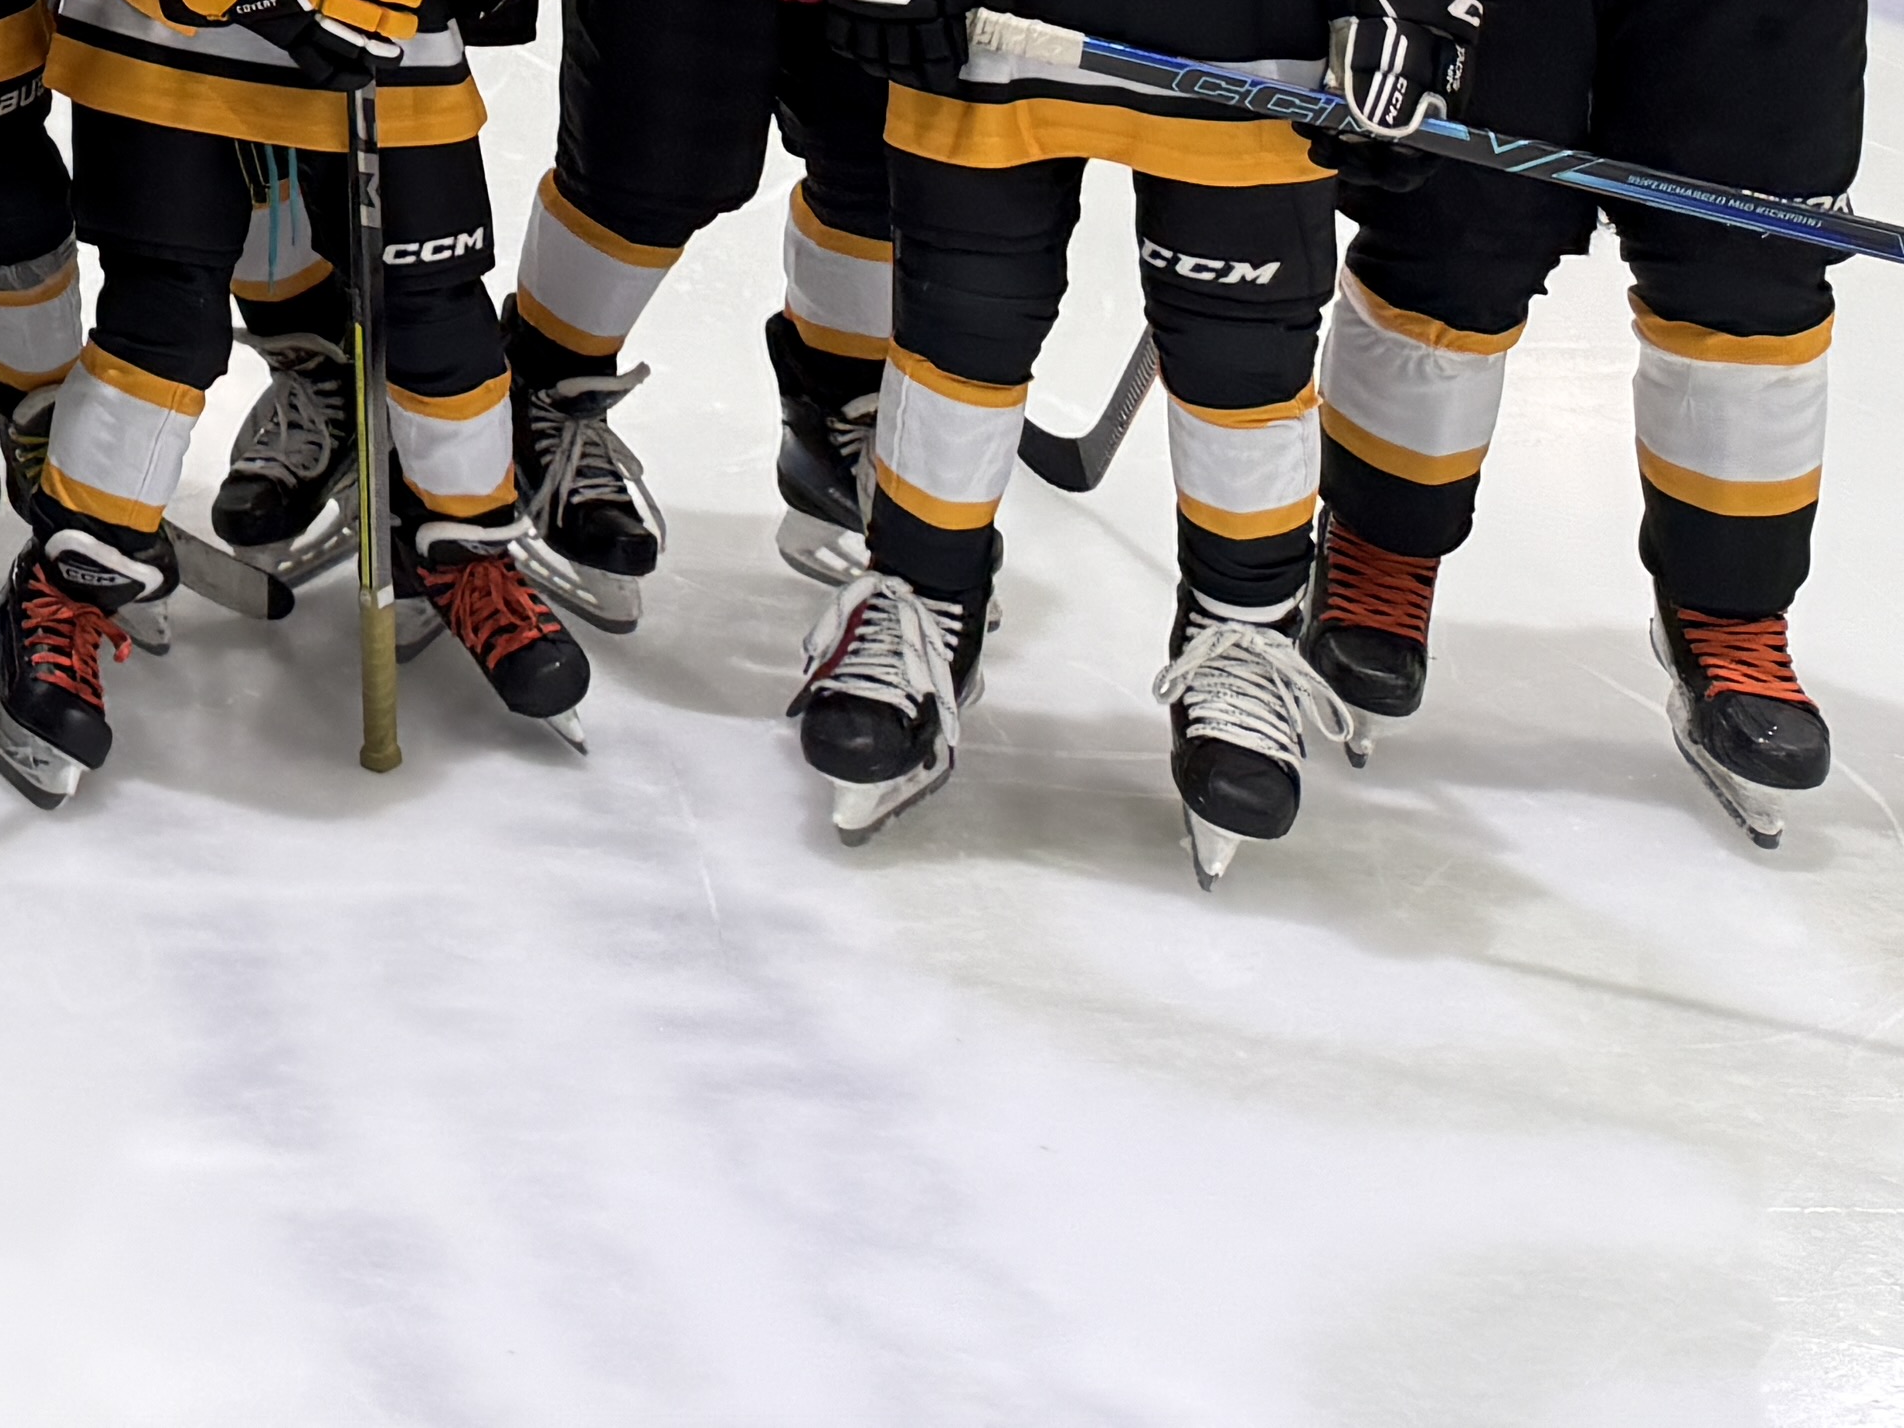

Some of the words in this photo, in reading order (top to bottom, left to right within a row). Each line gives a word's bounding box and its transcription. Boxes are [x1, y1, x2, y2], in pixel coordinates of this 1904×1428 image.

[1385, 75, 1408, 126] CCM
[382, 226, 485, 266] CCM
[1142, 238, 1282, 287] CCM
